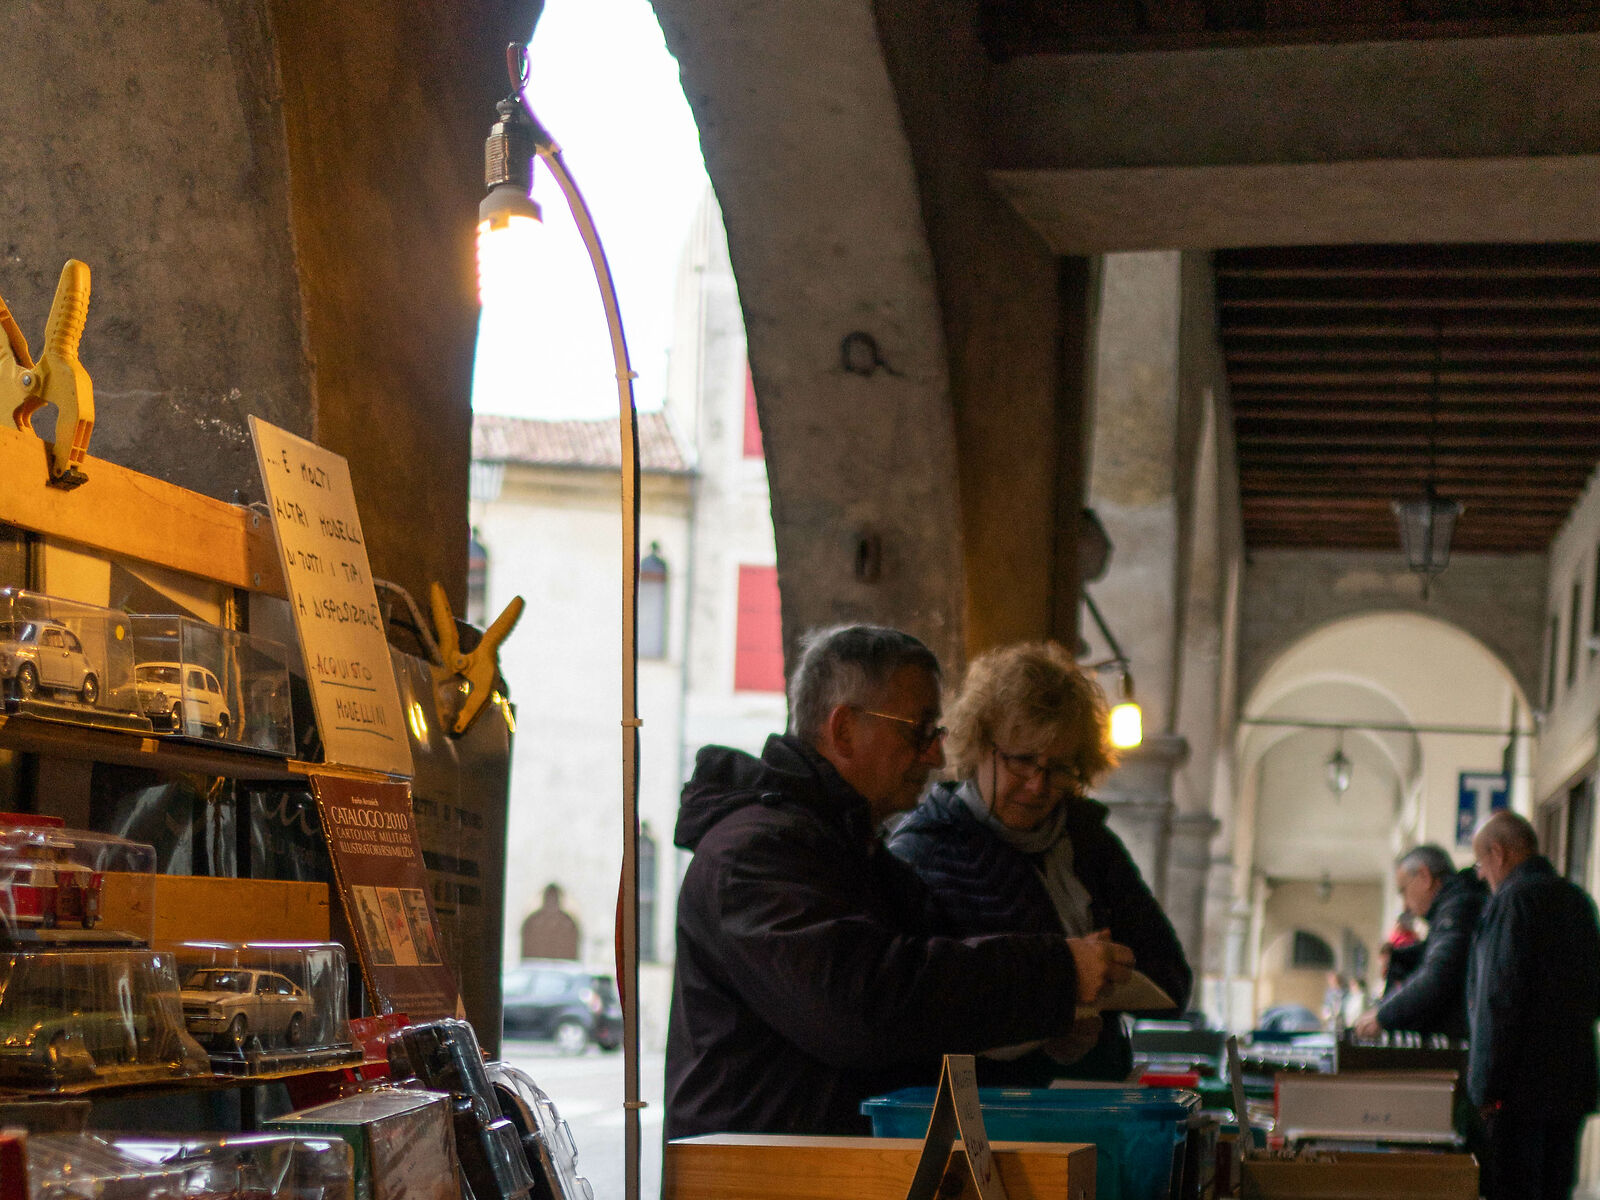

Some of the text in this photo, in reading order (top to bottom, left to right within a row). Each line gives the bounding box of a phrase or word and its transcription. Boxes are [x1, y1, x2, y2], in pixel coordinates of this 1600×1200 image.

[301, 464, 331, 492] MOLTI
[275, 495, 309, 529] ALTRI
[297, 550, 323, 575] TUTTI
[298, 592, 379, 631] A DISPOSIZIONE
[331, 806, 409, 831] CATALOGO 2010
[336, 826, 412, 844] CARTOLINE MILITARI
